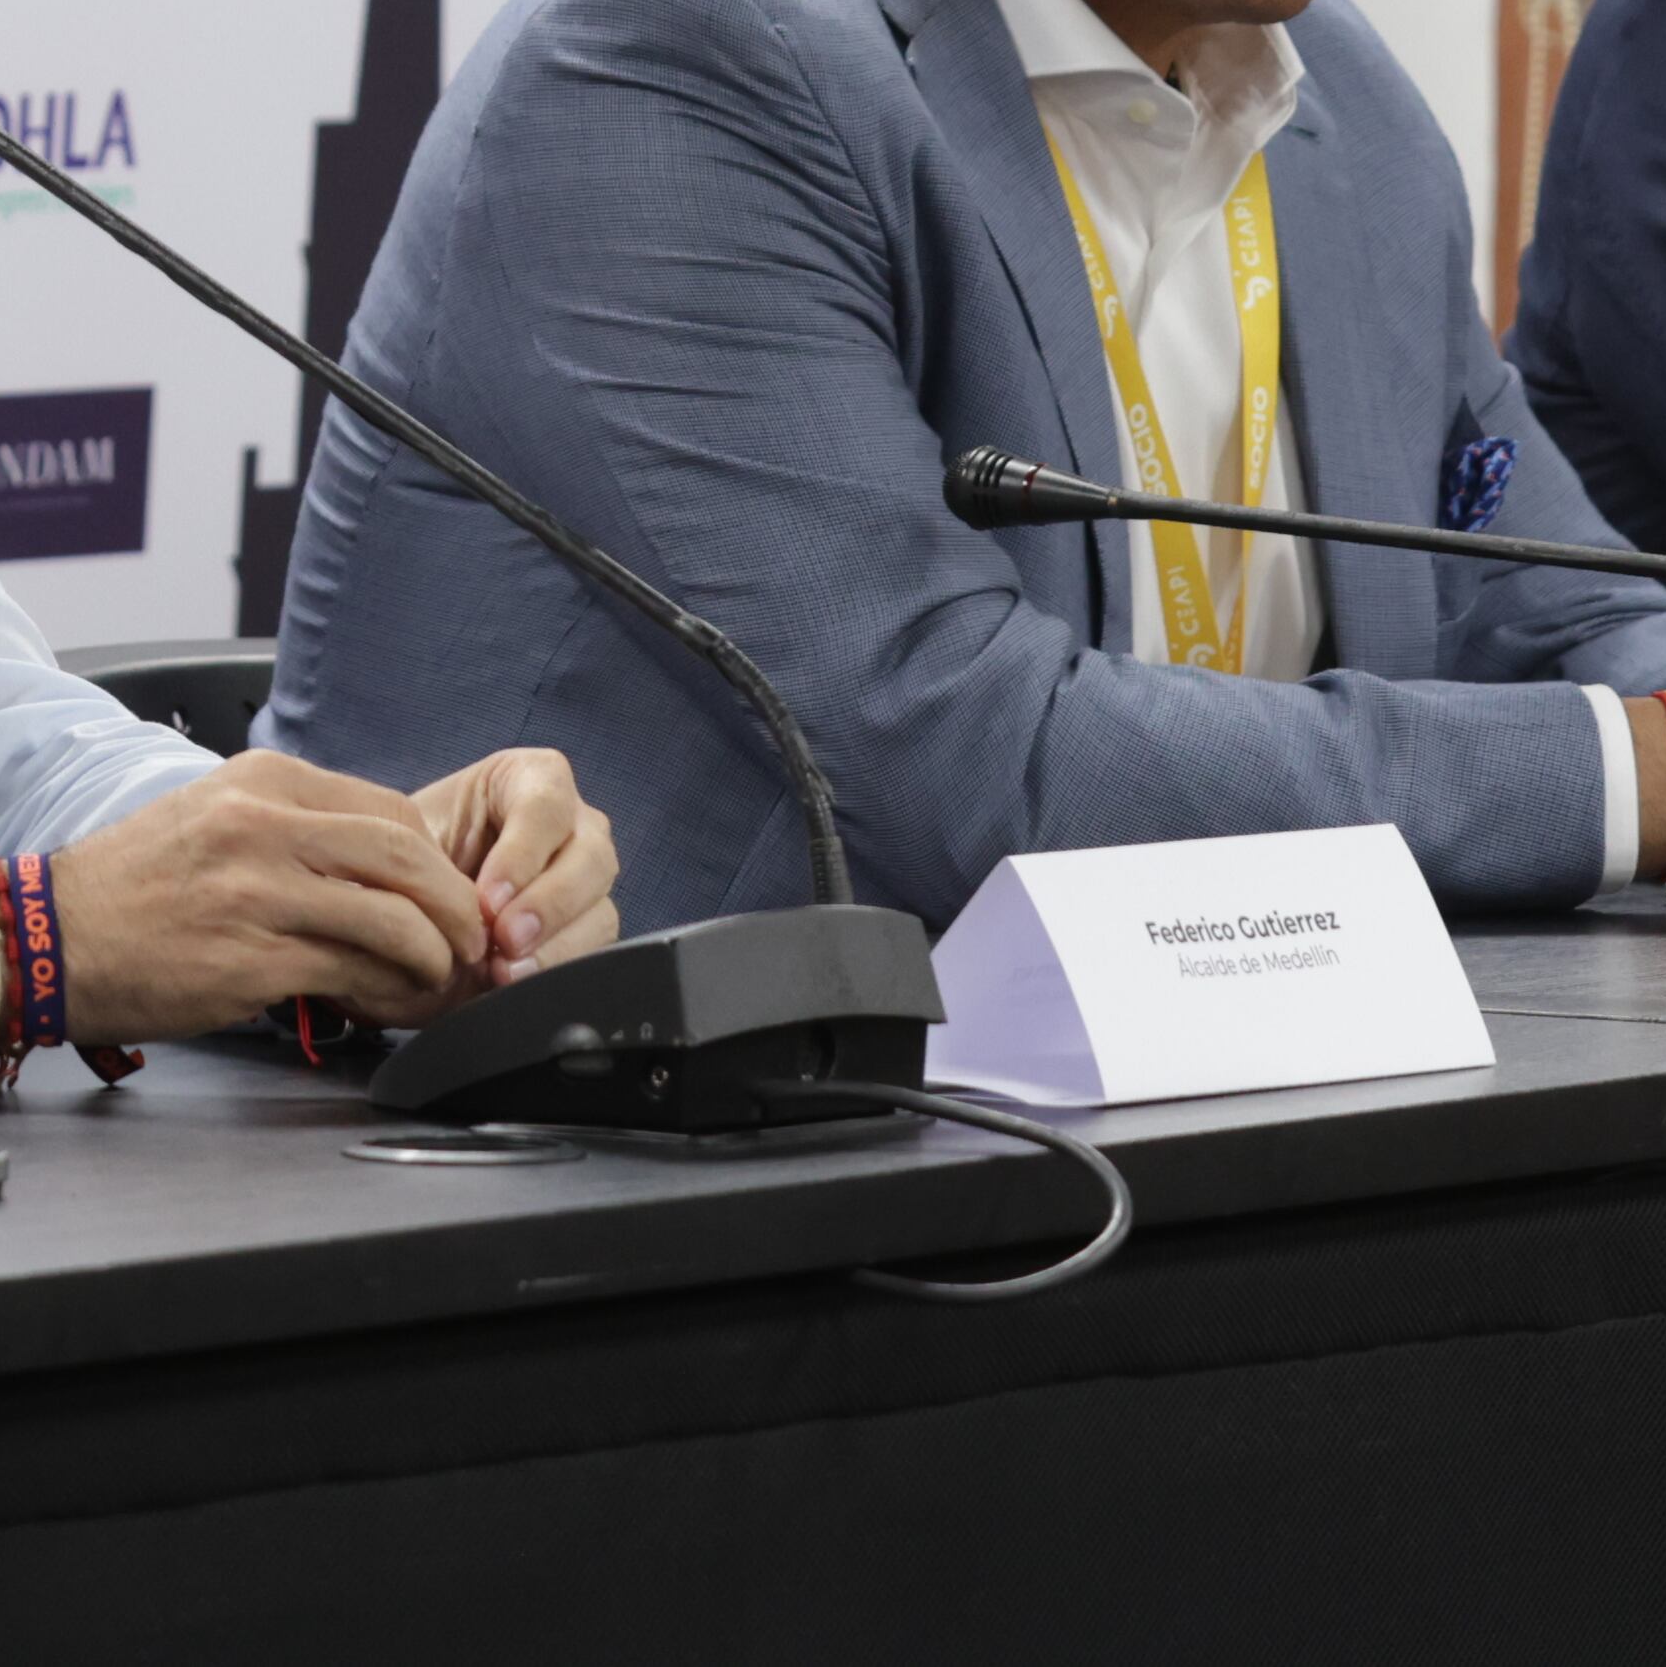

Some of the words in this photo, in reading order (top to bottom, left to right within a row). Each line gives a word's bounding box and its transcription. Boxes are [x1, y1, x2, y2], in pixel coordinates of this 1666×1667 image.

[1249, 386, 1269, 490] SOCIO
[22, 896, 53, 954] SOY
[1145, 915, 1236, 946] Federico
[1237, 910, 1342, 940] Gutierrez
[31, 956, 56, 1003] YO
[1238, 952, 1263, 975] de
